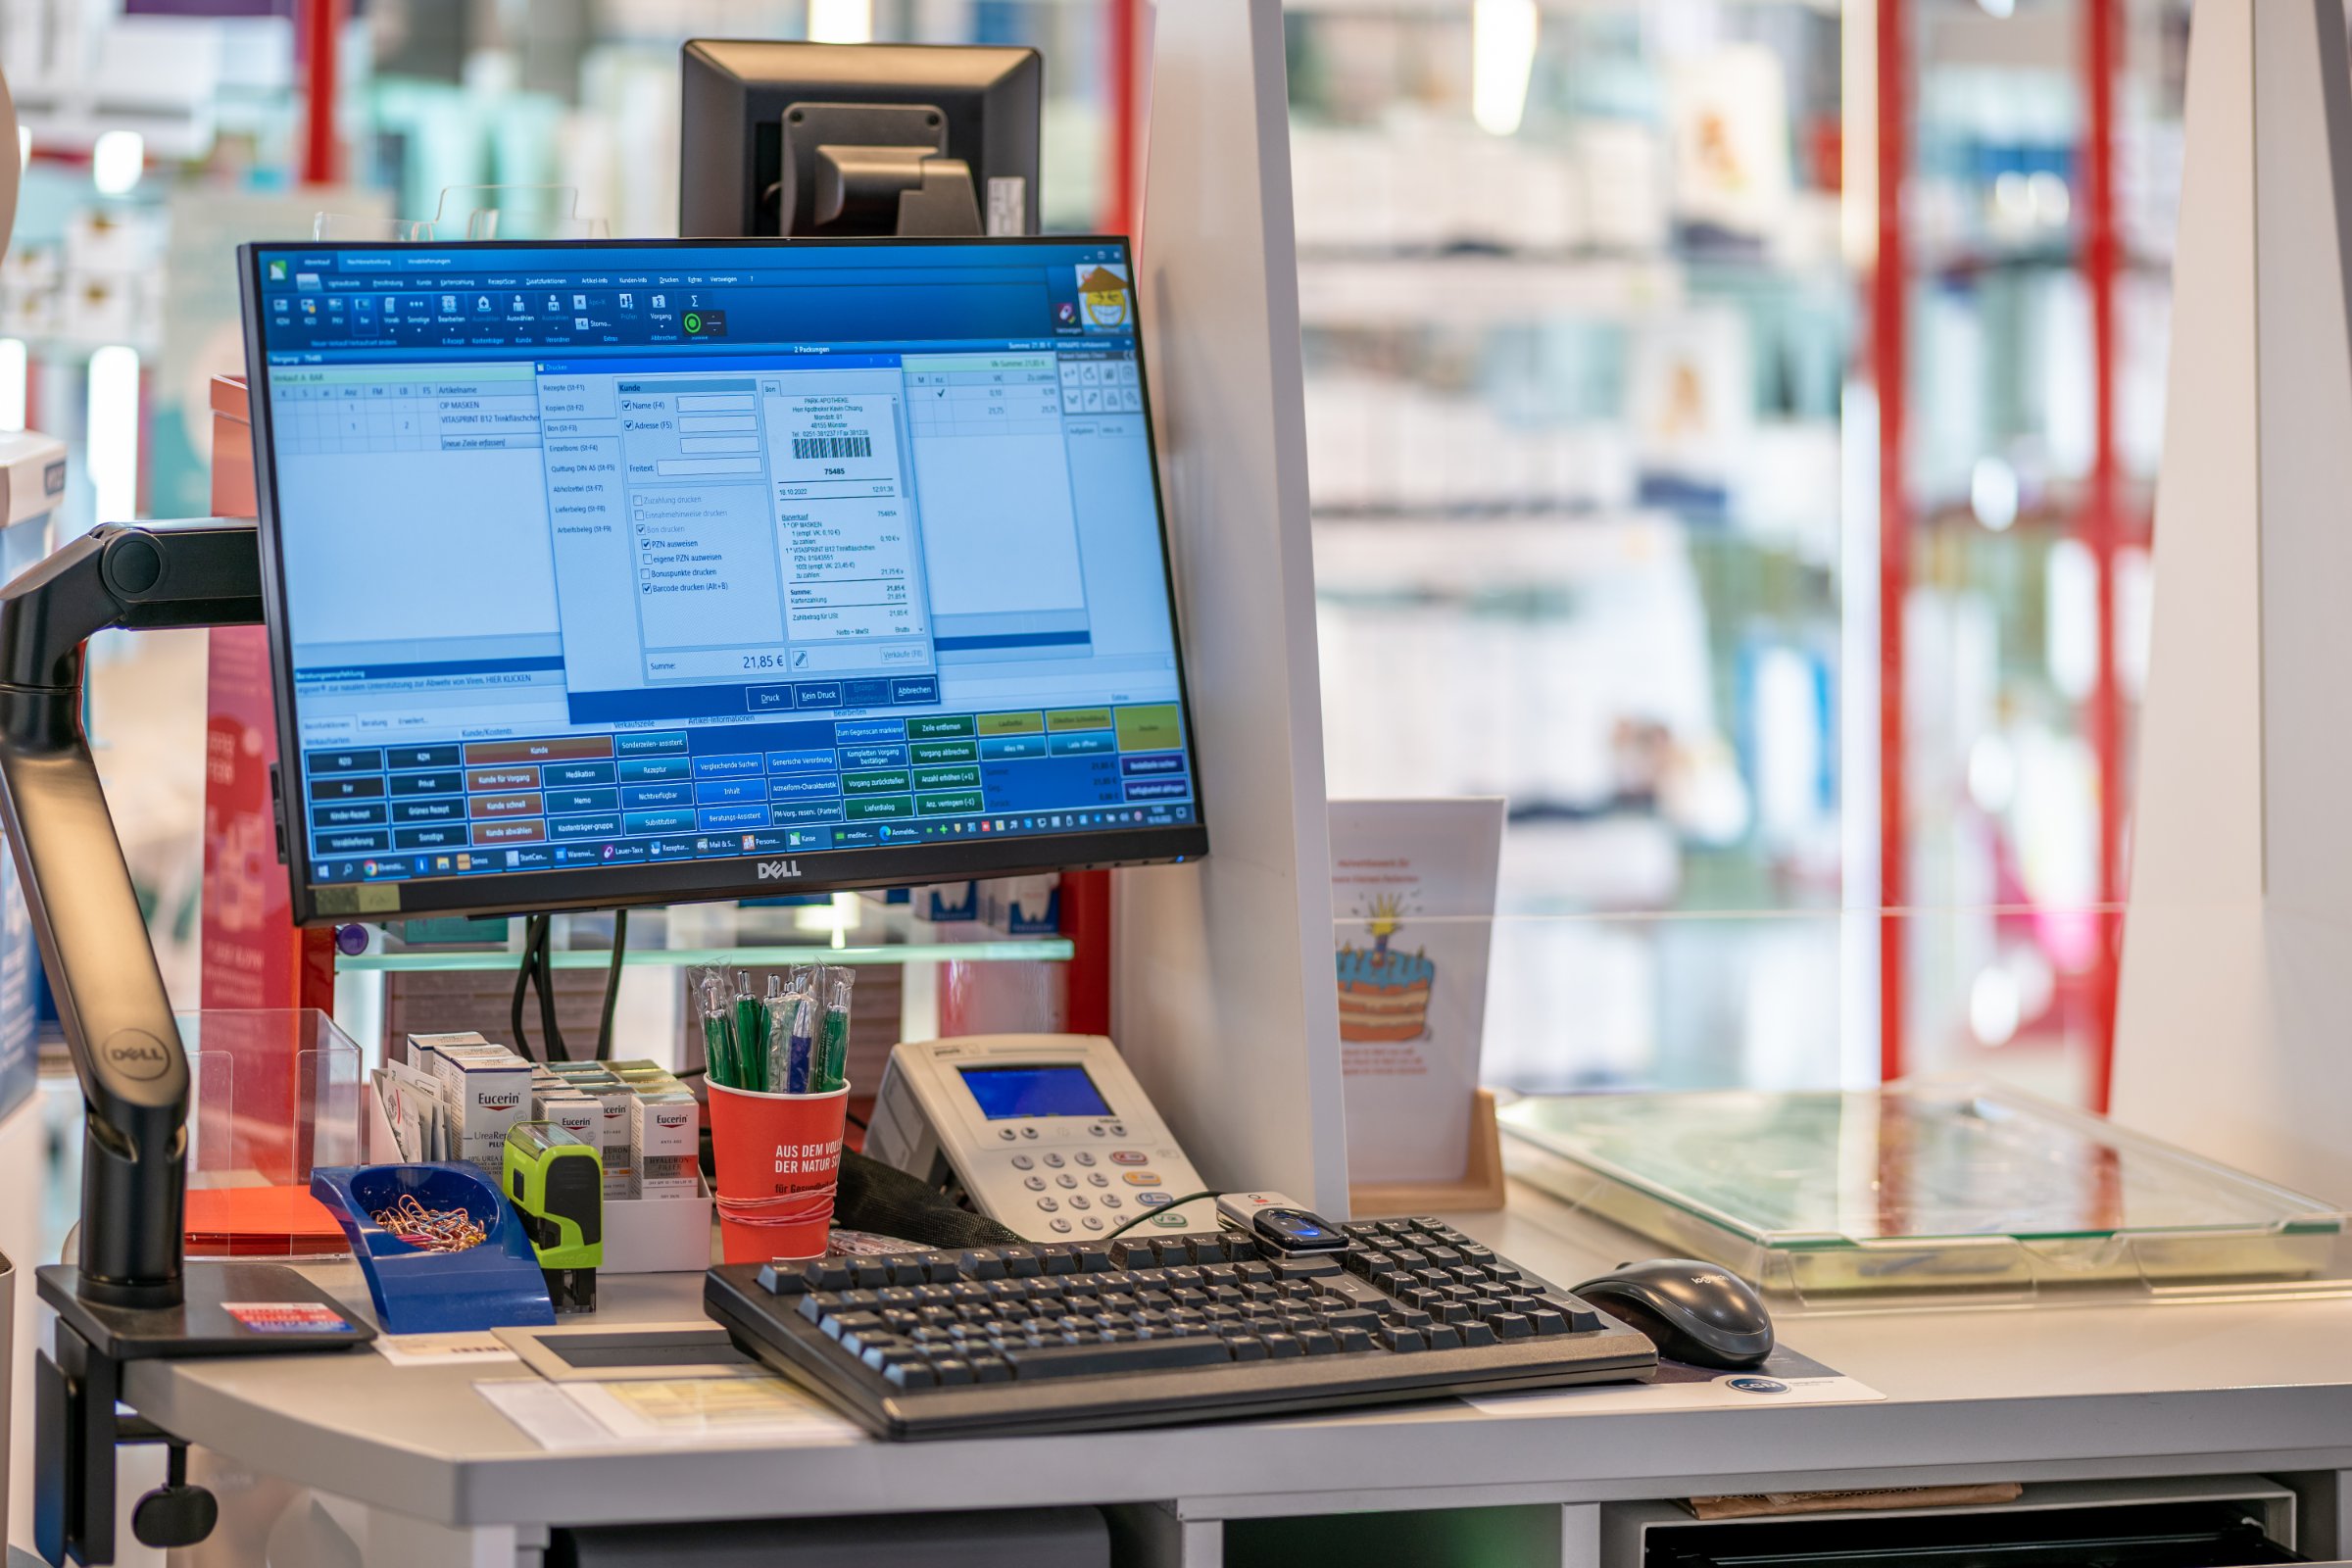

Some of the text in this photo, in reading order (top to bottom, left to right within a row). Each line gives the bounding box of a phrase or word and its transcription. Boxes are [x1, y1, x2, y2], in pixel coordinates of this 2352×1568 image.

[659, 275, 679, 285] Drucken
[651, 313, 673, 323] Vorgang
[439, 386, 477, 395] Artikelname
[619, 383, 641, 392] Kunde
[440, 400, 480, 410] OP MASKEN
[546, 404, 565, 414] Kopien
[632, 400, 665, 411] Name (F4)
[441, 416, 478, 424] VITASPRINT
[635, 419, 673, 430] Adresse (F5)
[677, 495, 702, 504] drucken
[703, 510, 728, 518] drucken
[647, 524, 685, 534] Bon drucken
[652, 539, 699, 549] PZN ausweisen
[653, 553, 722, 564] eigene PZN ausweisen
[651, 567, 717, 579] Bonuspunkte drucken
[653, 584, 679, 593] Barcode
[679, 582, 706, 592] drucken
[650, 662, 676, 672] Summe:
[743, 655, 784, 670] 21,85 €
[485, 674, 501, 684] HIER
[502, 673, 532, 683] KLICKEN
[802, 692, 816, 702] Kein
[816, 690, 836, 700] Druck
[898, 685, 932, 697] Abbrechen
[760, 694, 780, 704] Druck
[837, 726, 878, 738] Zum Gegenscan
[530, 746, 549, 755] Kunde
[877, 748, 900, 759] Vorgang
[737, 760, 759, 769] Suchen
[802, 755, 833, 766] Verordnung
[565, 769, 596, 779] Medikation
[643, 765, 667, 776] Rezeptur
[848, 779, 871, 790] Vorgang
[724, 787, 741, 796] Inhalt
[573, 796, 592, 806] Memo
[864, 802, 896, 814] Lieferdialog
[645, 816, 677, 826] Substitution
[558, 820, 613, 833] Kostenträger-gruppe
[801, 834, 816, 843] Kasse
[709, 840, 721, 849] Mail
[614, 846, 644, 856] Lauer-Taxe
[758, 860, 802, 879] DELL
[111, 1046, 164, 1062] DELL
[478, 1092, 520, 1105] Eucerin
[604, 1105, 627, 1114] cerin
[562, 1117, 592, 1127] Eucerin
[657, 1114, 688, 1124] Eucerin
[775, 1145, 799, 1158] AUS
[802, 1143, 824, 1158] DEM
[774, 1159, 799, 1174] DER
[802, 1157, 830, 1173] NATUR
[774, 1183, 788, 1195] für
